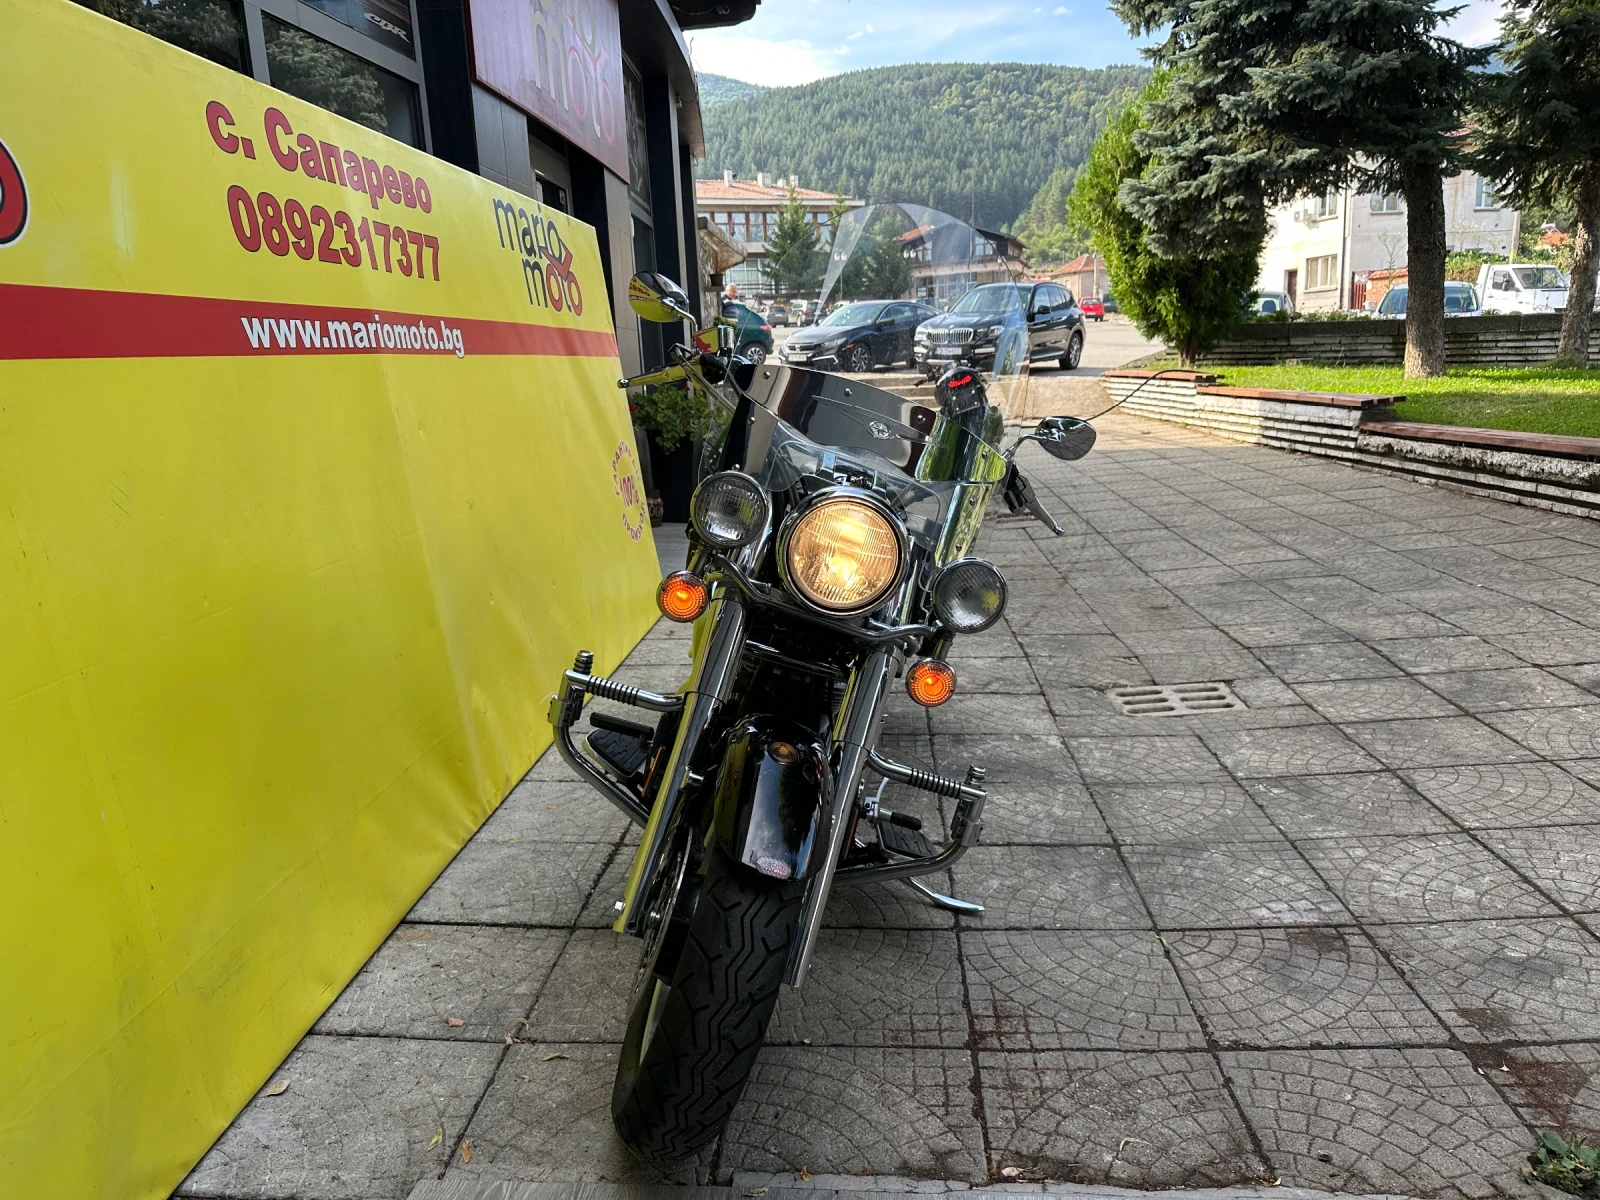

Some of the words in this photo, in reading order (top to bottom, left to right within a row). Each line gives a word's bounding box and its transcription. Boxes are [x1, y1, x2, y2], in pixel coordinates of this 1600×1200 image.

[263, 106, 433, 214] Сапарево
[226, 184, 440, 282] 0892317377
[492, 198, 563, 263] mario
[521, 256, 583, 317] moto
[240, 313, 466, 359] www.mariomoto.bg
